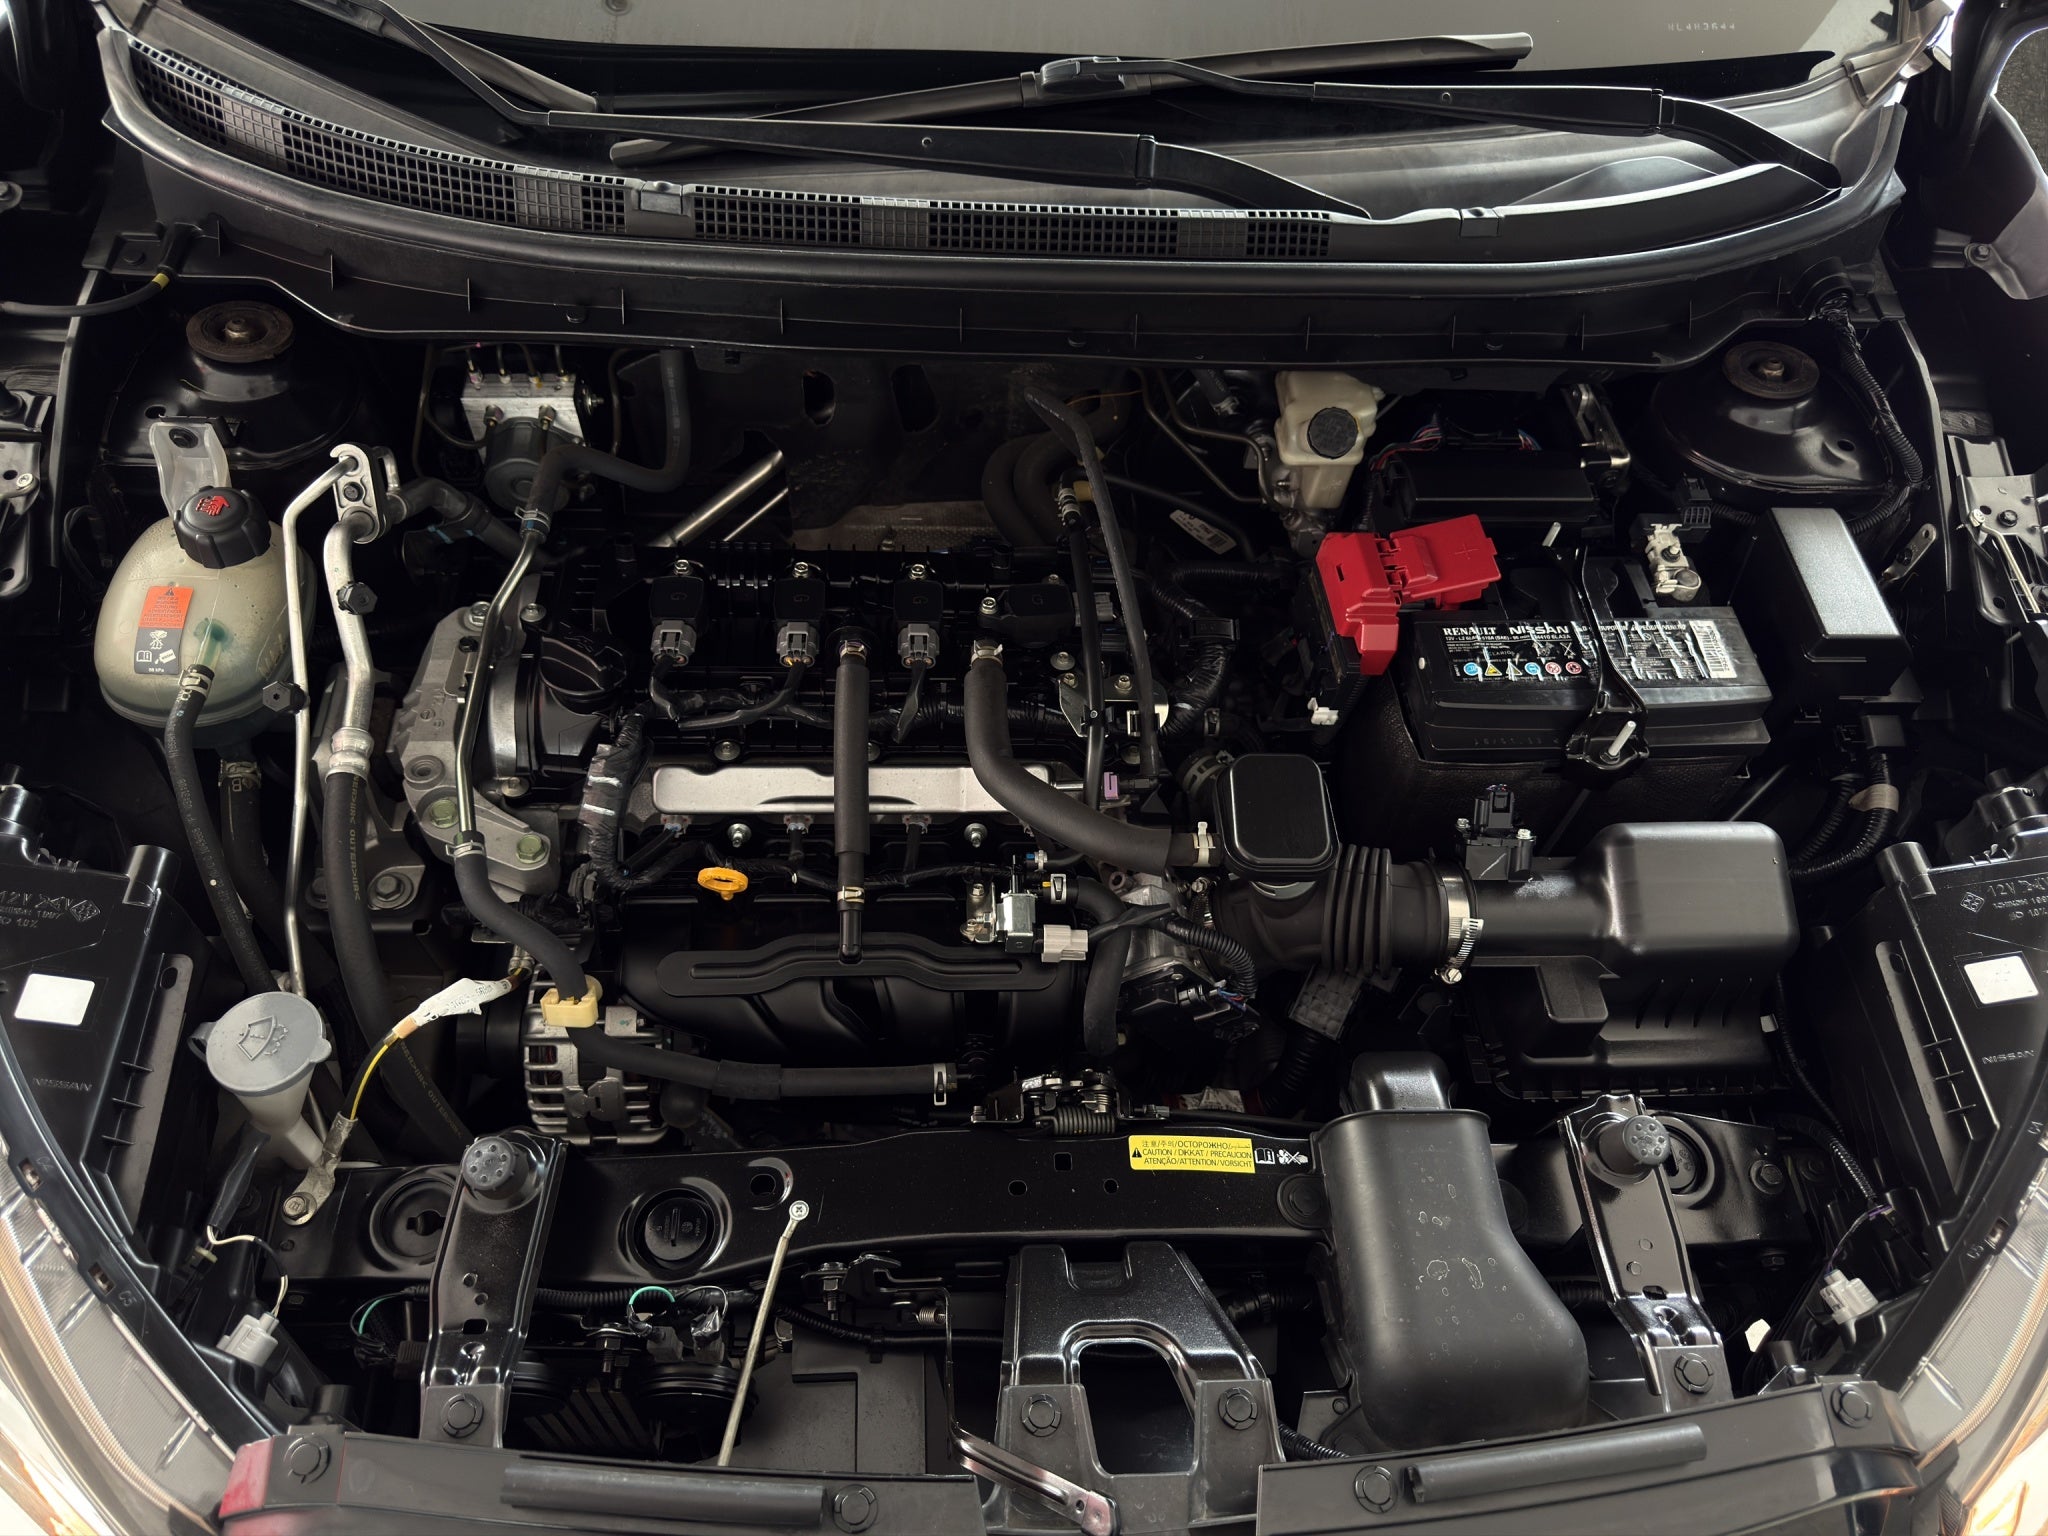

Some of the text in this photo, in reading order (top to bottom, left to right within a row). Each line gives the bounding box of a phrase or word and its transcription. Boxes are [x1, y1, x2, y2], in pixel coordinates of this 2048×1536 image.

[1442, 626, 1497, 636] RENAULT
[1509, 625, 1570, 635] NISSAN
[1981, 1050, 2036, 1065] NISSAN
[1142, 1148, 1172, 1156] CAUTION
[1178, 1149, 1204, 1157] DIKKAT
